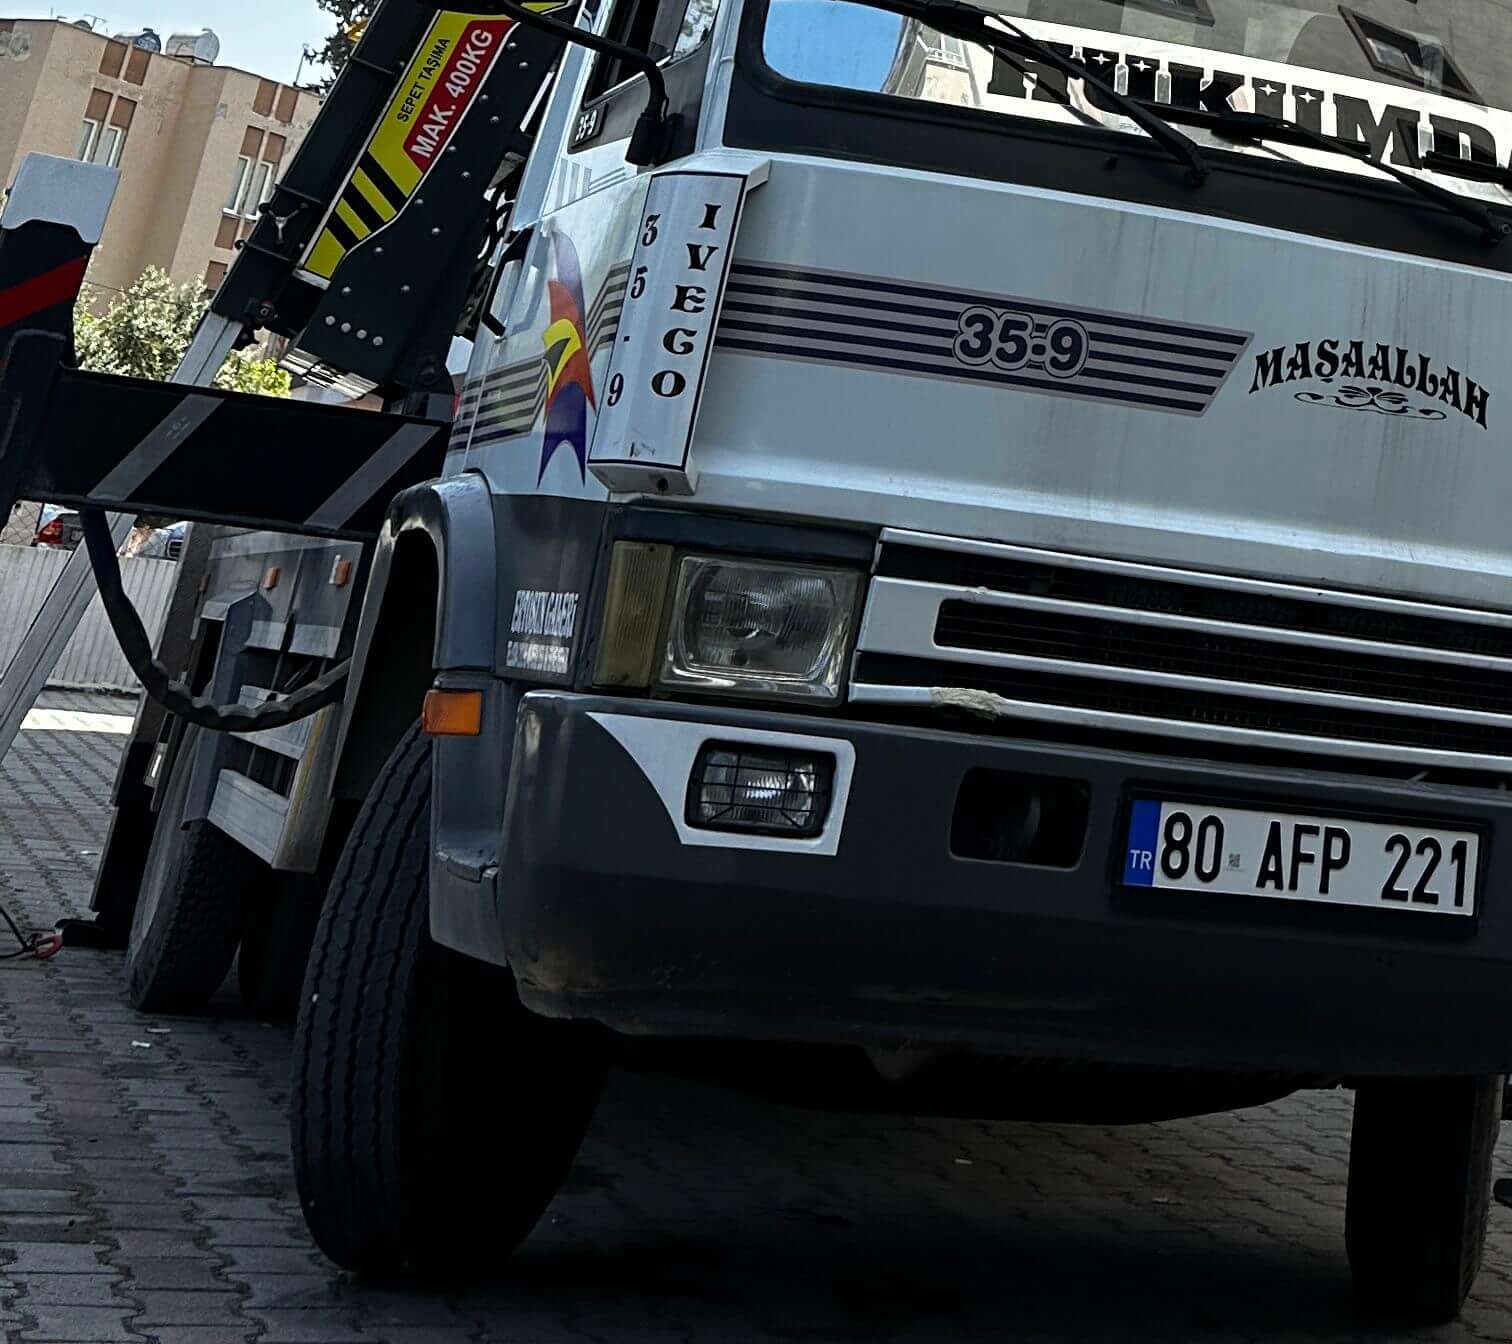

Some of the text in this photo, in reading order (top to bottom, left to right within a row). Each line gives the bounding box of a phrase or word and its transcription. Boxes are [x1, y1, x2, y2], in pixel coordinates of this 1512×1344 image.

[397, 37, 451, 123] SEPET TAŞIMA
[411, 28, 494, 159] MAK. 400KG
[1248, 340, 1490, 430] MAŞAALLAH
[1130, 811, 1469, 908] TR 80 AFP 221
